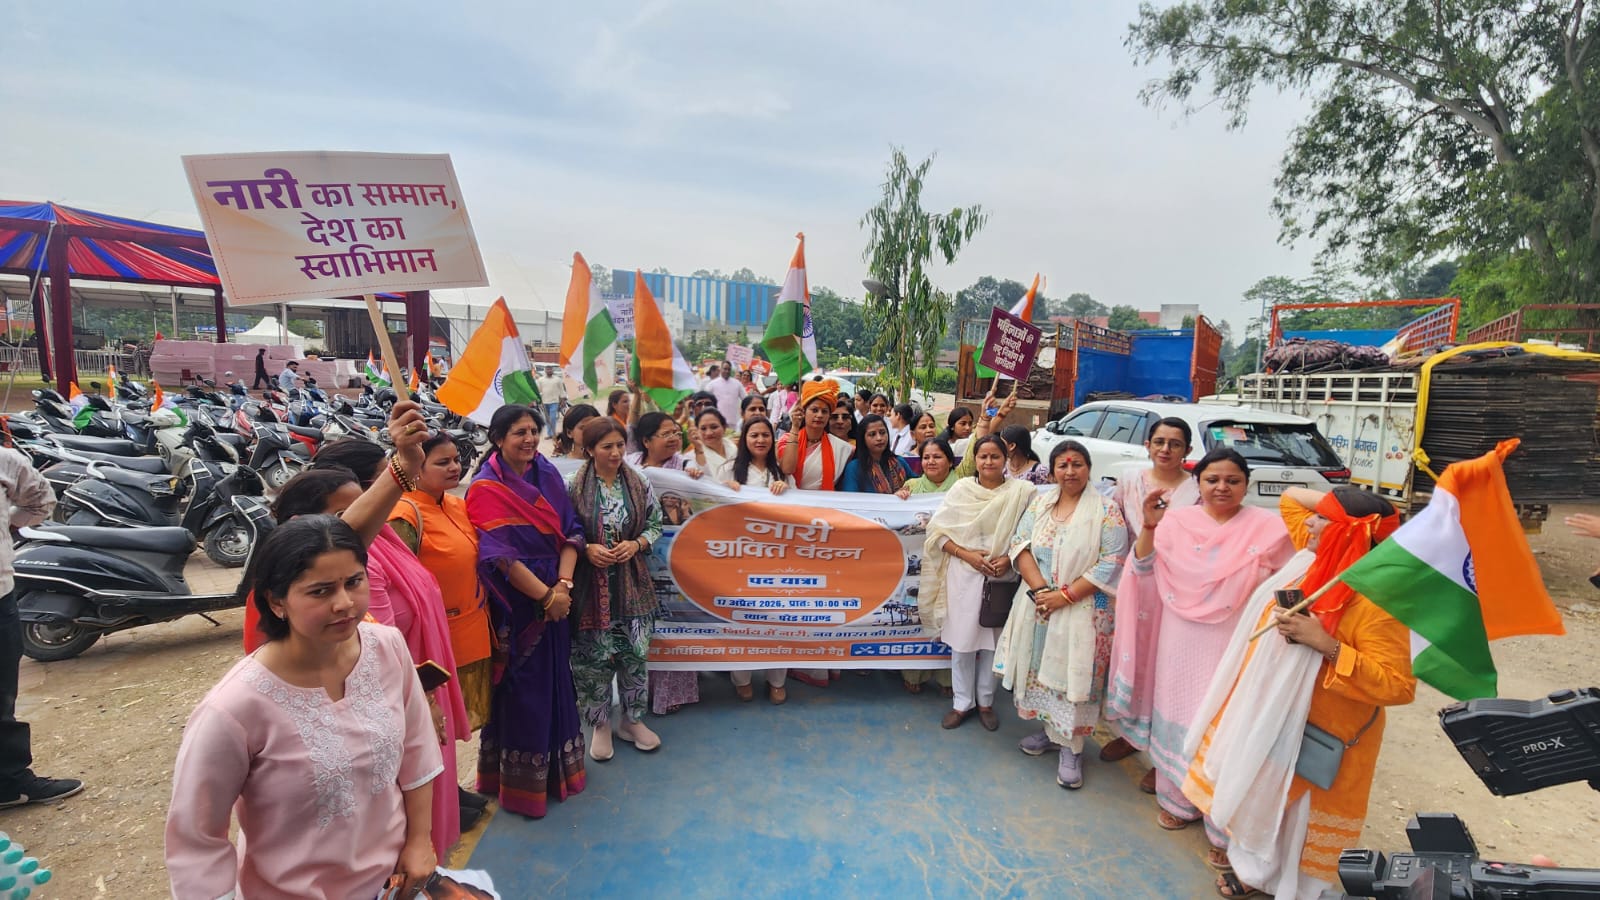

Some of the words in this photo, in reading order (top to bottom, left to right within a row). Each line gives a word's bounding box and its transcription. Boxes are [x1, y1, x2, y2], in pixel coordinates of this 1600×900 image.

[206, 168, 302, 210] नारी
[306, 184, 354, 208] का
[357, 183, 457, 210] सम्मान,
[300, 212, 359, 246] देश
[361, 217, 406, 241] का
[295, 244, 439, 280] स्वाभिमान
[997, 317, 1028, 341] महिलाओं
[1026, 334, 1034, 344] की
[744, 517, 834, 543] नारी
[705, 536, 788, 558] शक्ति
[795, 544, 864, 560] वंदन
[749, 577, 774, 585] पद
[781, 577, 818, 585] यात्रा
[729, 598, 756, 607] अप्रैल
[760, 600, 785, 608] 2026,
[815, 600, 839, 608] 10:00
[842, 599, 858, 608] बजे
[744, 613, 768, 621] स्थान
[779, 613, 798, 622] परेड
[722, 627, 761, 635] निर्णय
[764, 628, 777, 636] में
[870, 629, 887, 637] की
[888, 627, 922, 636] तैयारी
[664, 645, 725, 656] अधिनियम
[729, 646, 744, 655] का
[747, 645, 792, 655] समर्थन
[795, 646, 825, 655] करने
[828, 646, 845, 657] हेतु
[878, 643, 932, 655] 96671
[1522, 736, 1566, 754] PRO-X
